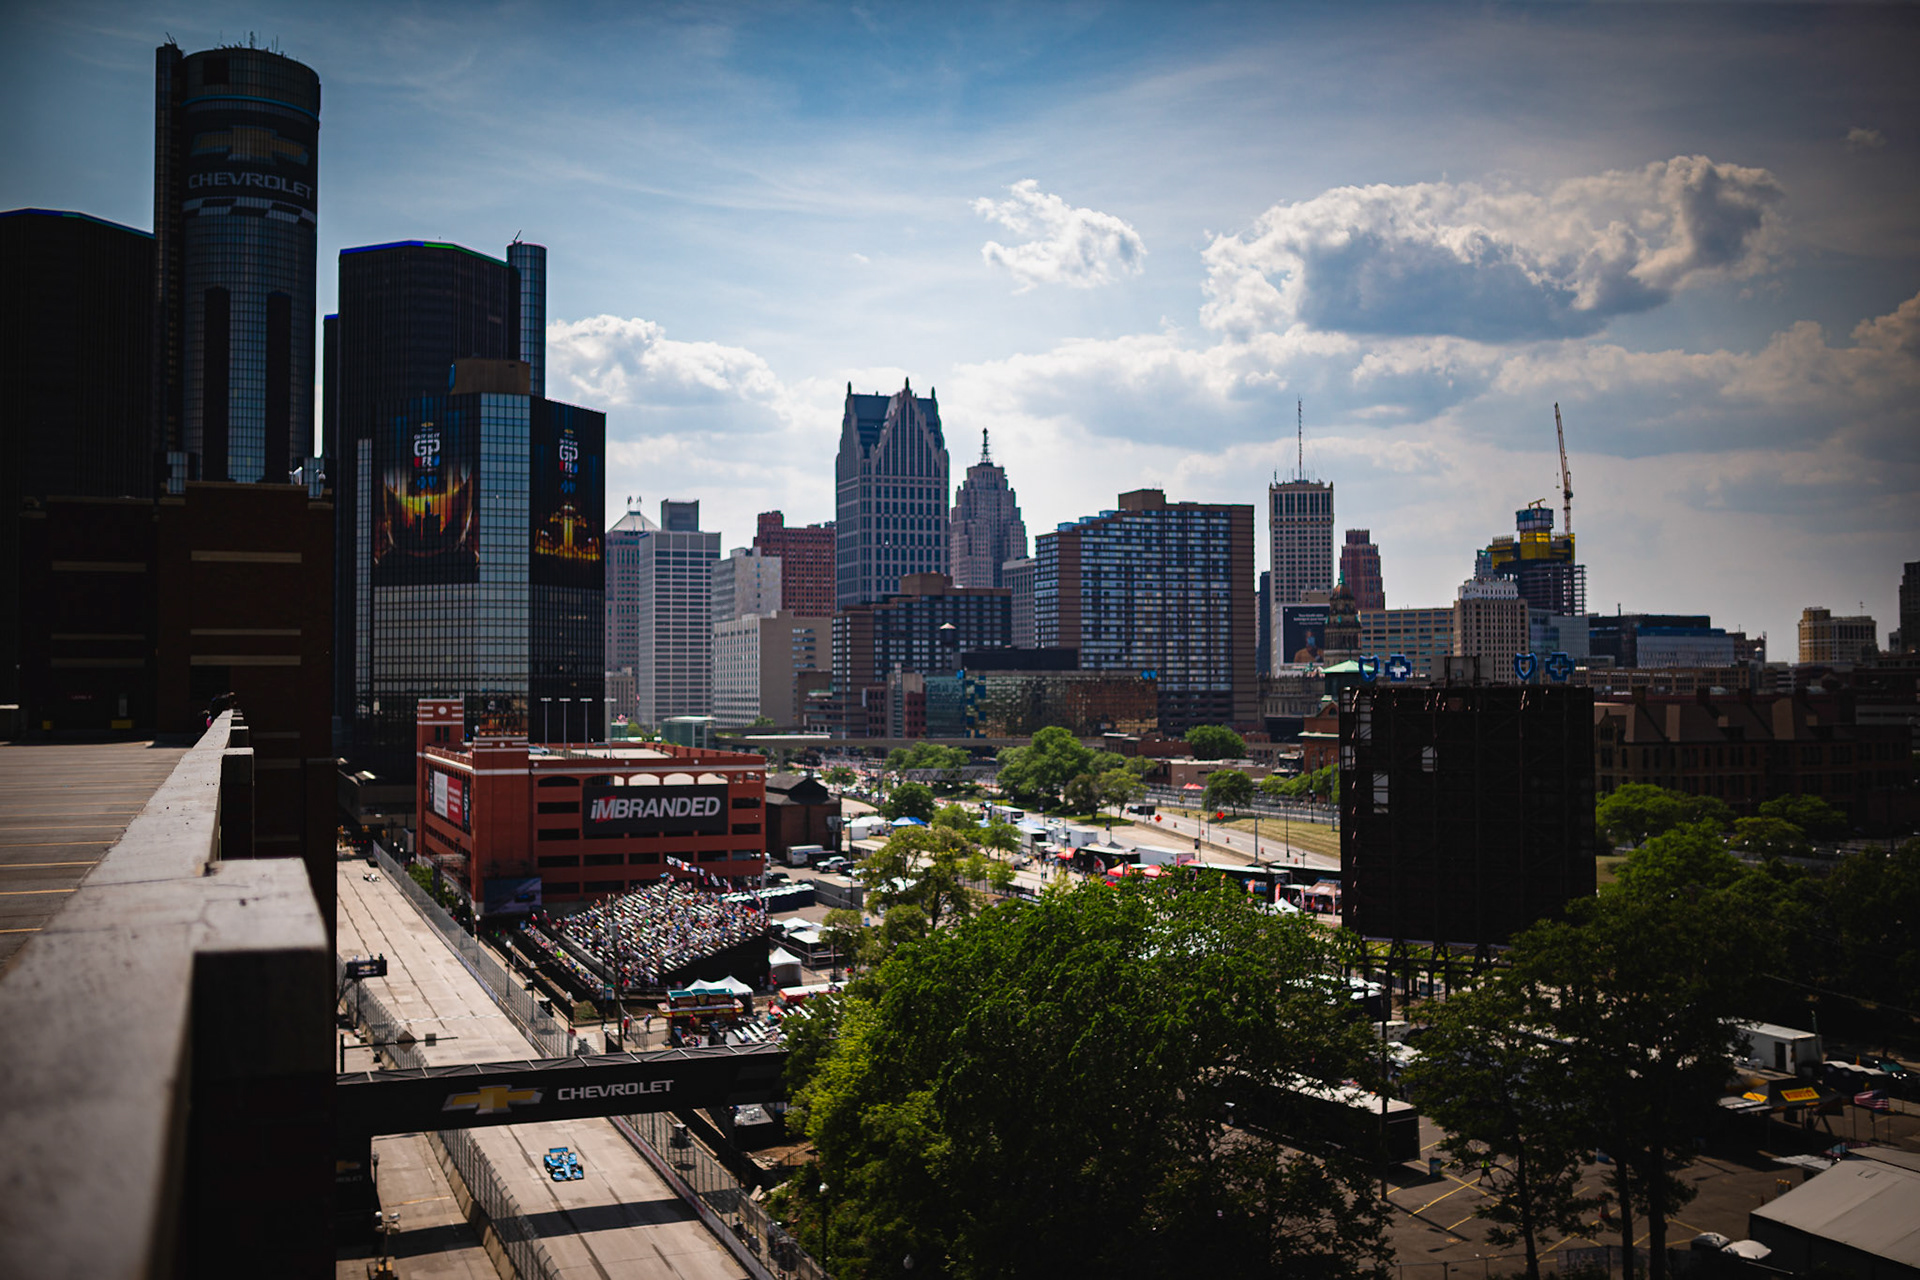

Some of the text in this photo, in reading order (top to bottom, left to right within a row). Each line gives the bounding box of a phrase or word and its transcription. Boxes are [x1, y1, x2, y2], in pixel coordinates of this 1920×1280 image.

[188, 171, 313, 200] CHEVROLET
[413, 439, 441, 457] GP
[559, 444, 579, 462] GP
[590, 796, 721, 820] iMBRANDED
[557, 1079, 674, 1101] CHEVROLET
